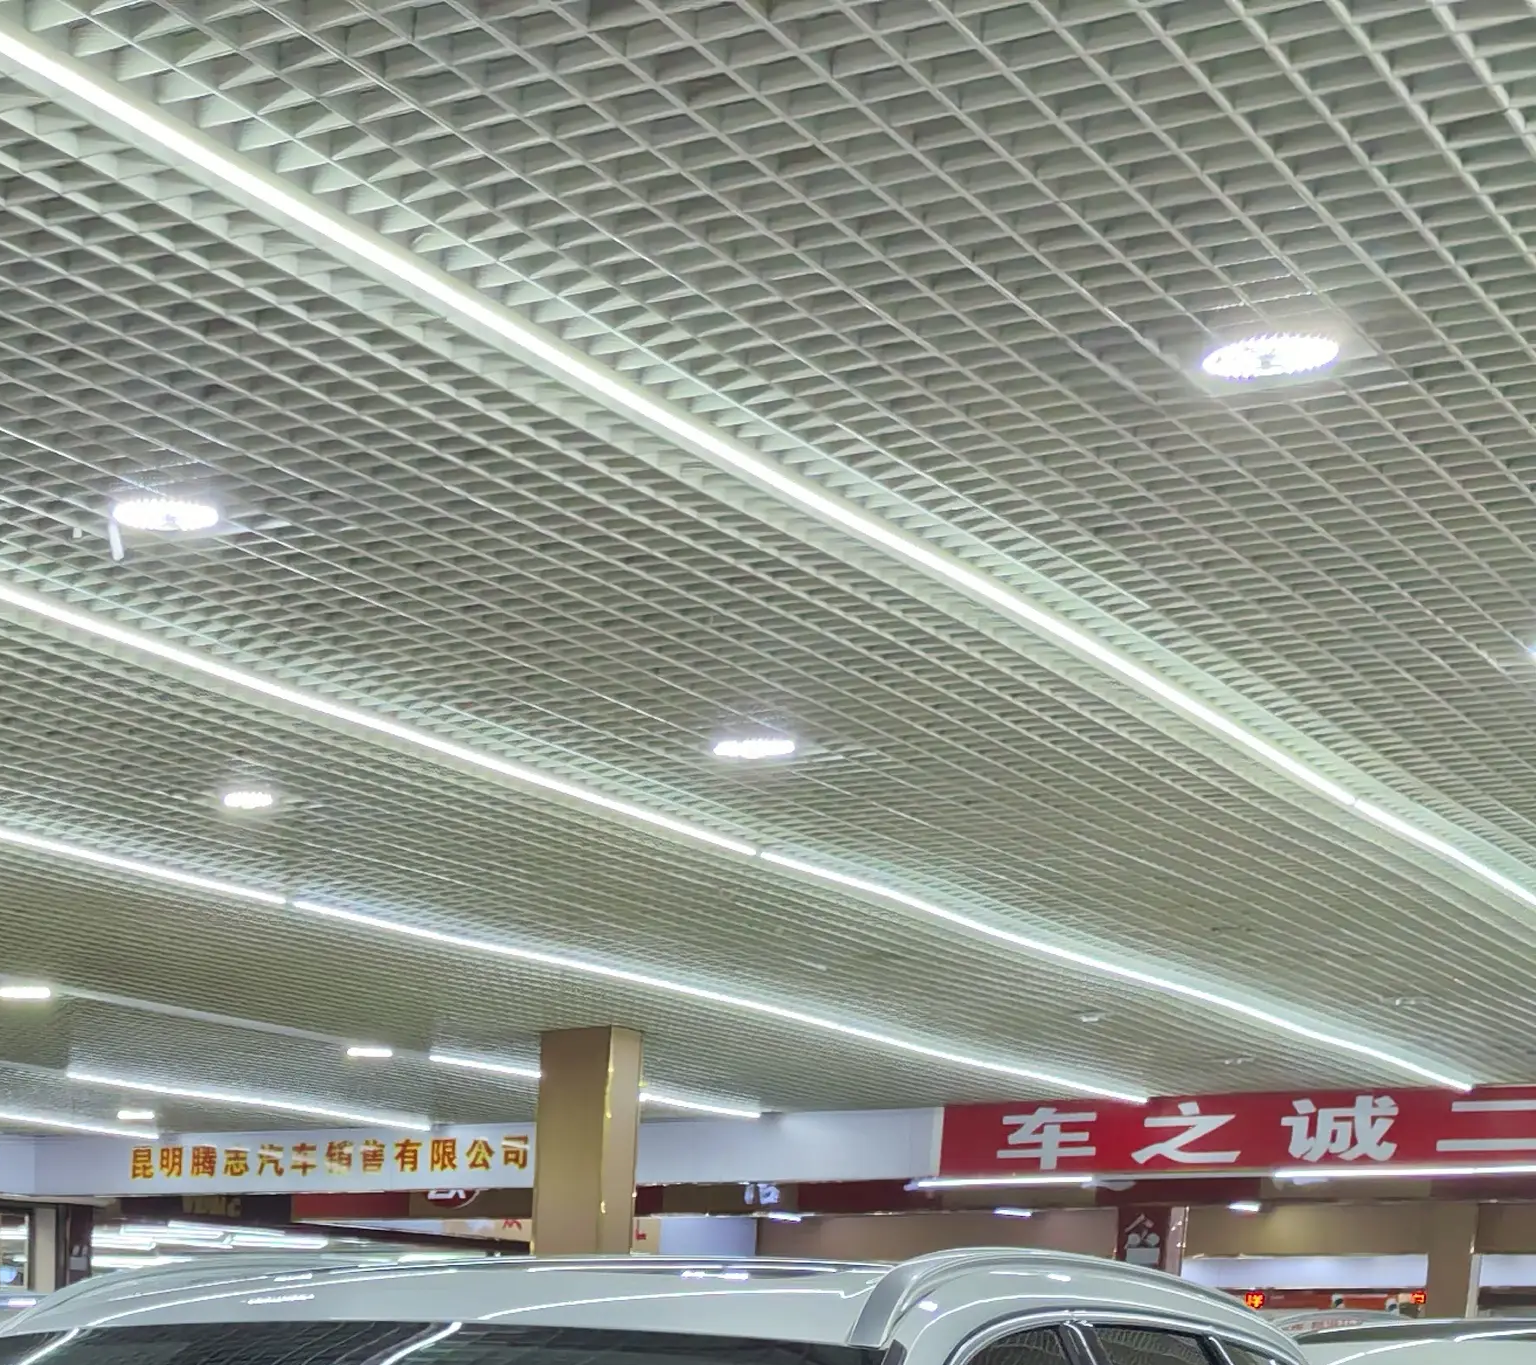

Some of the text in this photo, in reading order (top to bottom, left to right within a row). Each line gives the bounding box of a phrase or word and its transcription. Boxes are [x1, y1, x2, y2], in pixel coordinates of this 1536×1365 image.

[131, 1134, 530, 1180] 昆明腾志汽车销售有限公司
[995, 1096, 1536, 1170] 车之诚二
